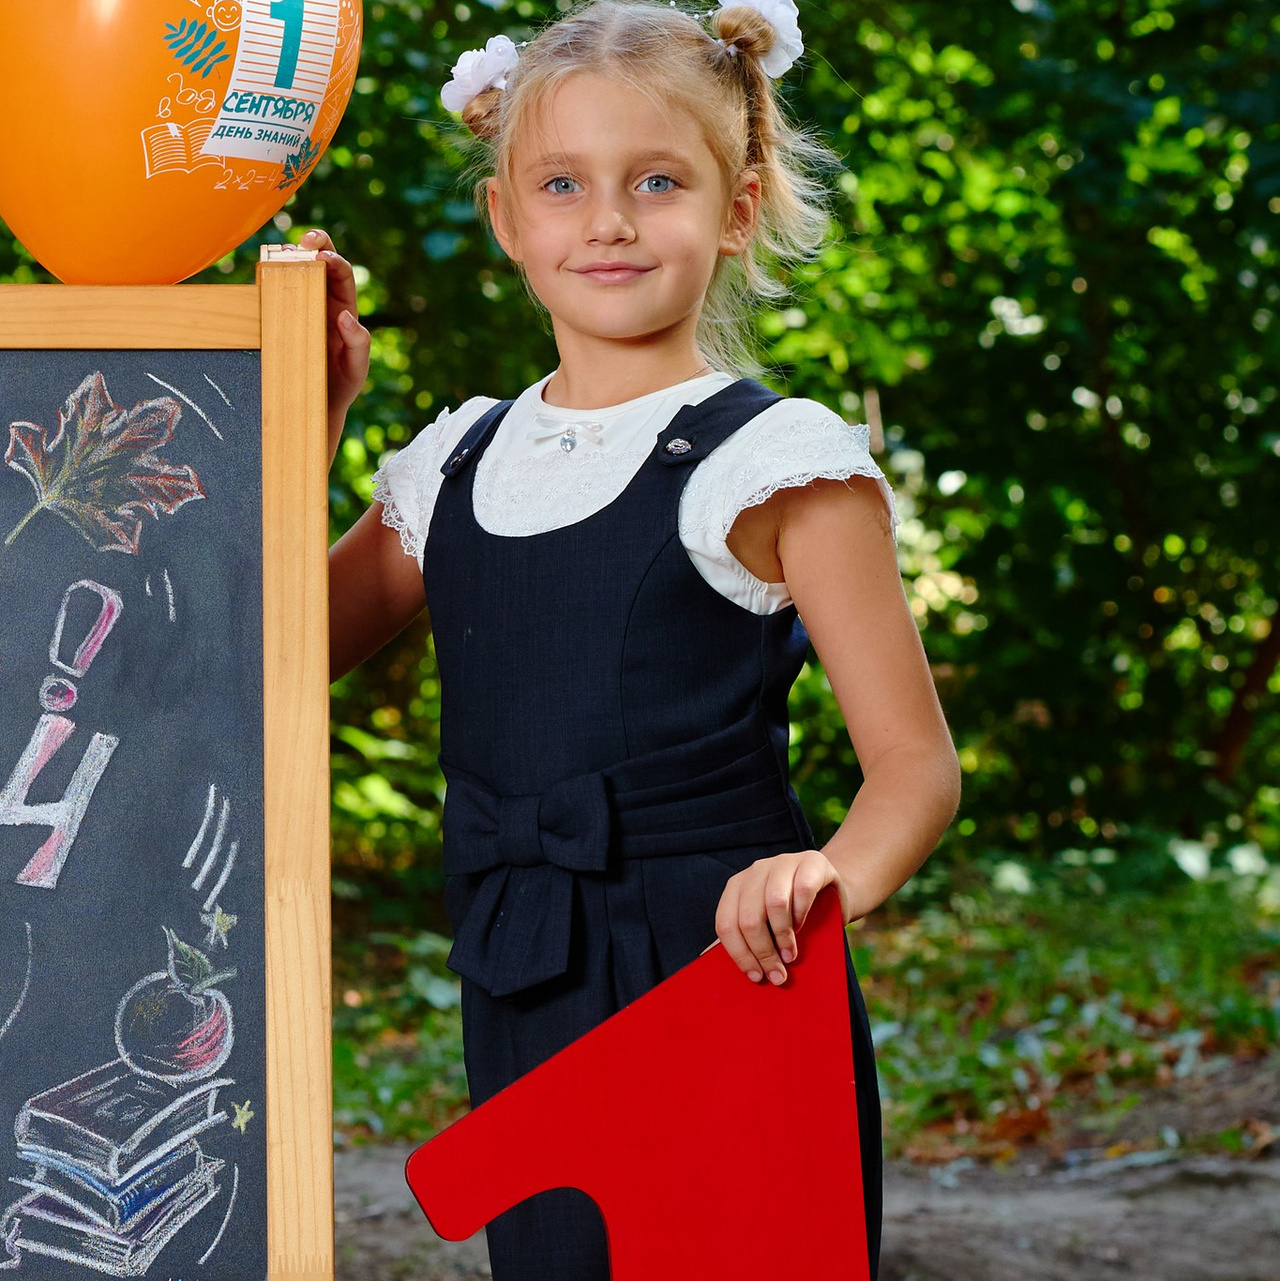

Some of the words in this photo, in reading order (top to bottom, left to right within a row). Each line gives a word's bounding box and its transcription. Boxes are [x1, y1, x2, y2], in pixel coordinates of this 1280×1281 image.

[222, 91, 316, 125] СЕНТЯБРЯ
[212, 124, 253, 140] ДЕНЬ
[254, 128, 302, 149] ЗНАНИЙ
